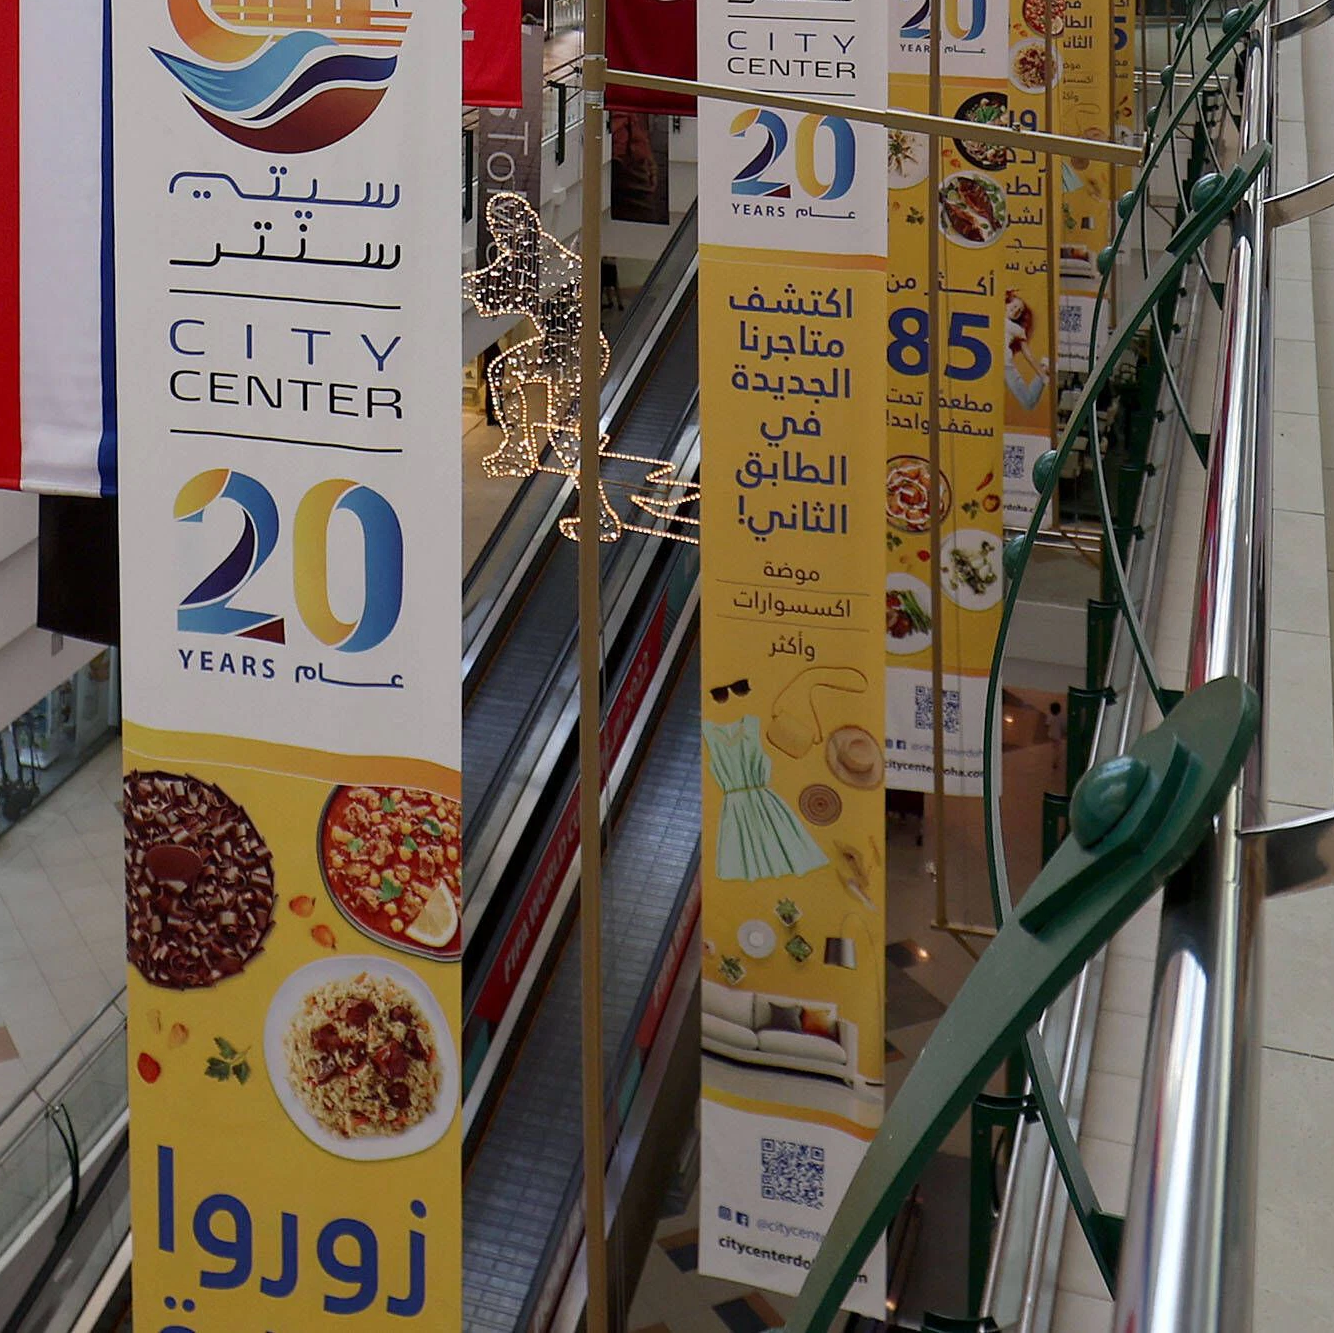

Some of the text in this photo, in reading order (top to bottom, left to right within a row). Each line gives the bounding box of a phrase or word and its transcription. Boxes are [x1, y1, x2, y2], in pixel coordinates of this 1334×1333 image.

[727, 30, 856, 55] CITY
[899, 43, 931, 54] YEAR
[727, 56, 857, 79] CENTER
[729, 107, 857, 201] 20
[169, 165, 401, 221] سيتي
[731, 202, 786, 218] YEARS
[795, 205, 856, 220] عام
[169, 220, 402, 271] سنتر
[729, 282, 854, 320] اكتشف
[169, 318, 403, 373] CITY
[739, 320, 846, 361] متاجرنا
[886, 307, 993, 382] 85
[169, 369, 404, 420] CENTER
[731, 363, 852, 404] الجديدة
[760, 410, 823, 447] في
[735, 450, 849, 489] الطابق
[738, 494, 849, 542] الثاني!
[171, 467, 405, 655] 20
[763, 560, 821, 585] موضة
[732, 589, 852, 619] اكسسوارات
[178, 648, 276, 680] YEARS
[768, 630, 816, 662] وأكثر
[295, 662, 404, 689] عام
[157, 1144, 428, 1318] زوروا
